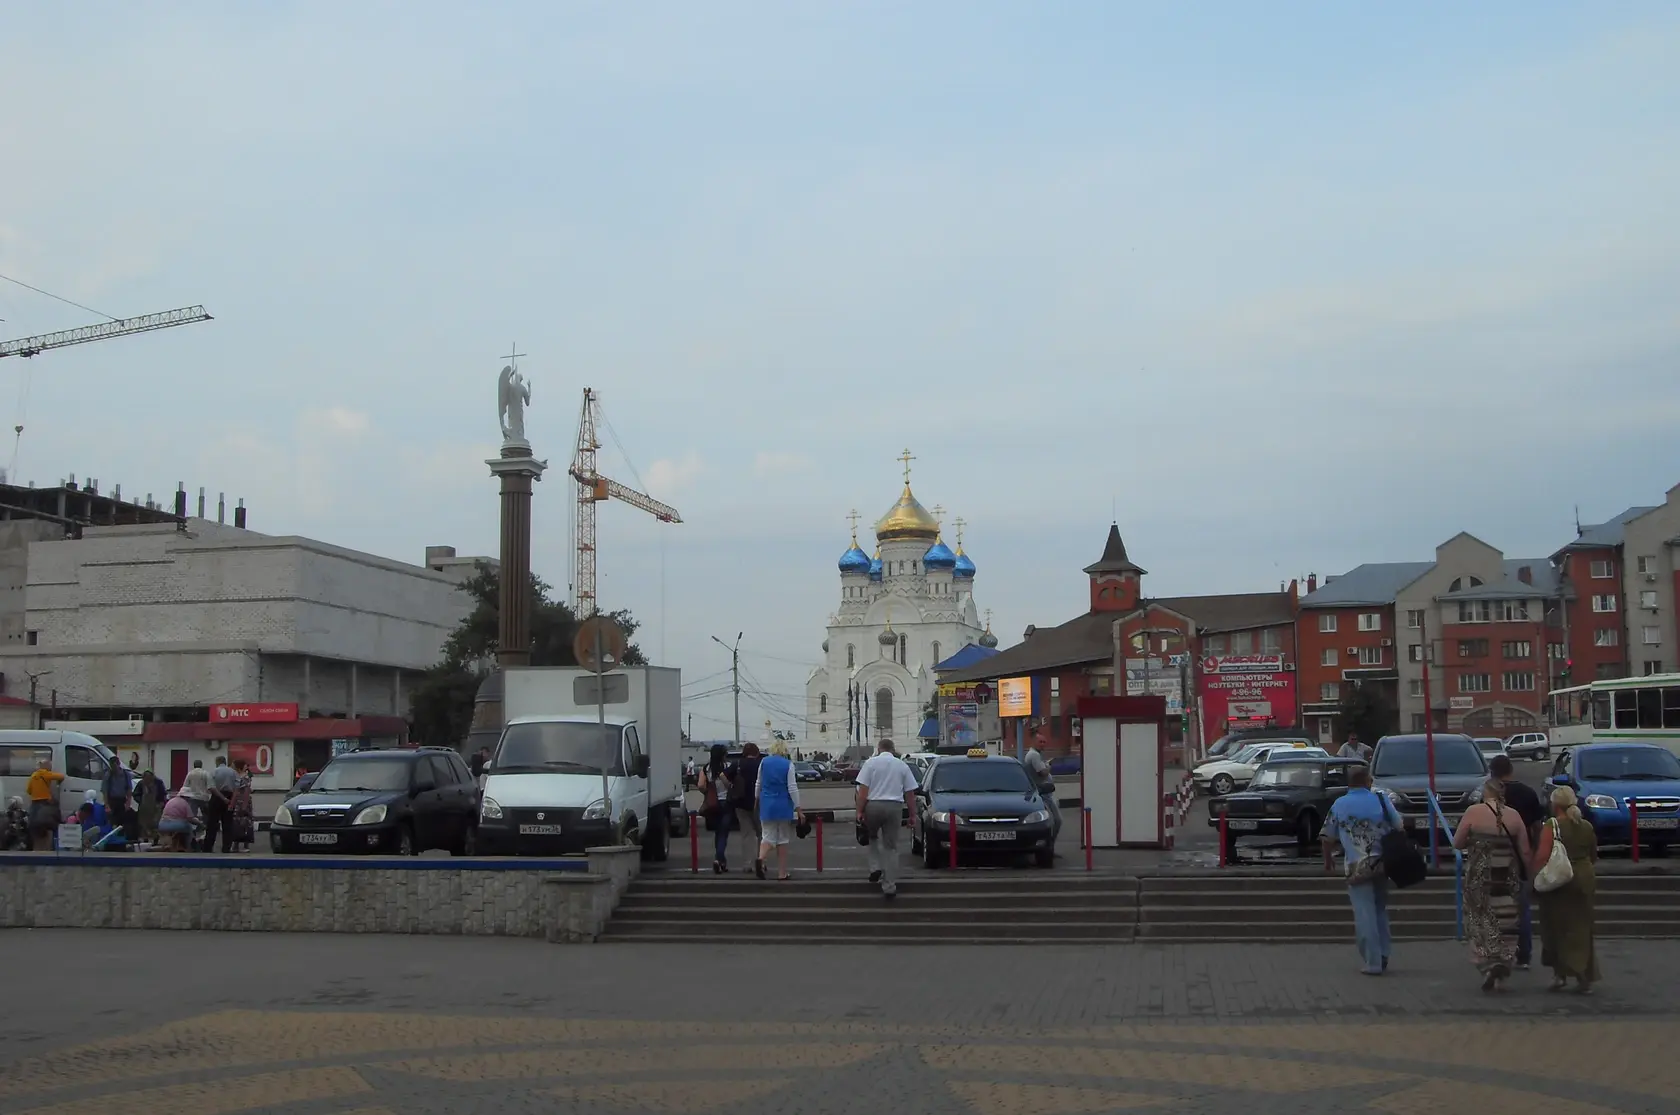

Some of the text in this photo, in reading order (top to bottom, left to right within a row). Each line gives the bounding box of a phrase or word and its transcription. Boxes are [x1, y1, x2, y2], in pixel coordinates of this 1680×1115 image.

[1203, 656, 1218, 672] 9
[1221, 674, 1273, 682] КОМПЬЮТЕРЫ
[1128, 681, 1159, 689] ОПТКА
[1251, 680, 1289, 688] ИНТЕРНЕТ
[1231, 688, 1262, 696] 4-96-96
[231, 708, 249, 717] МТС
